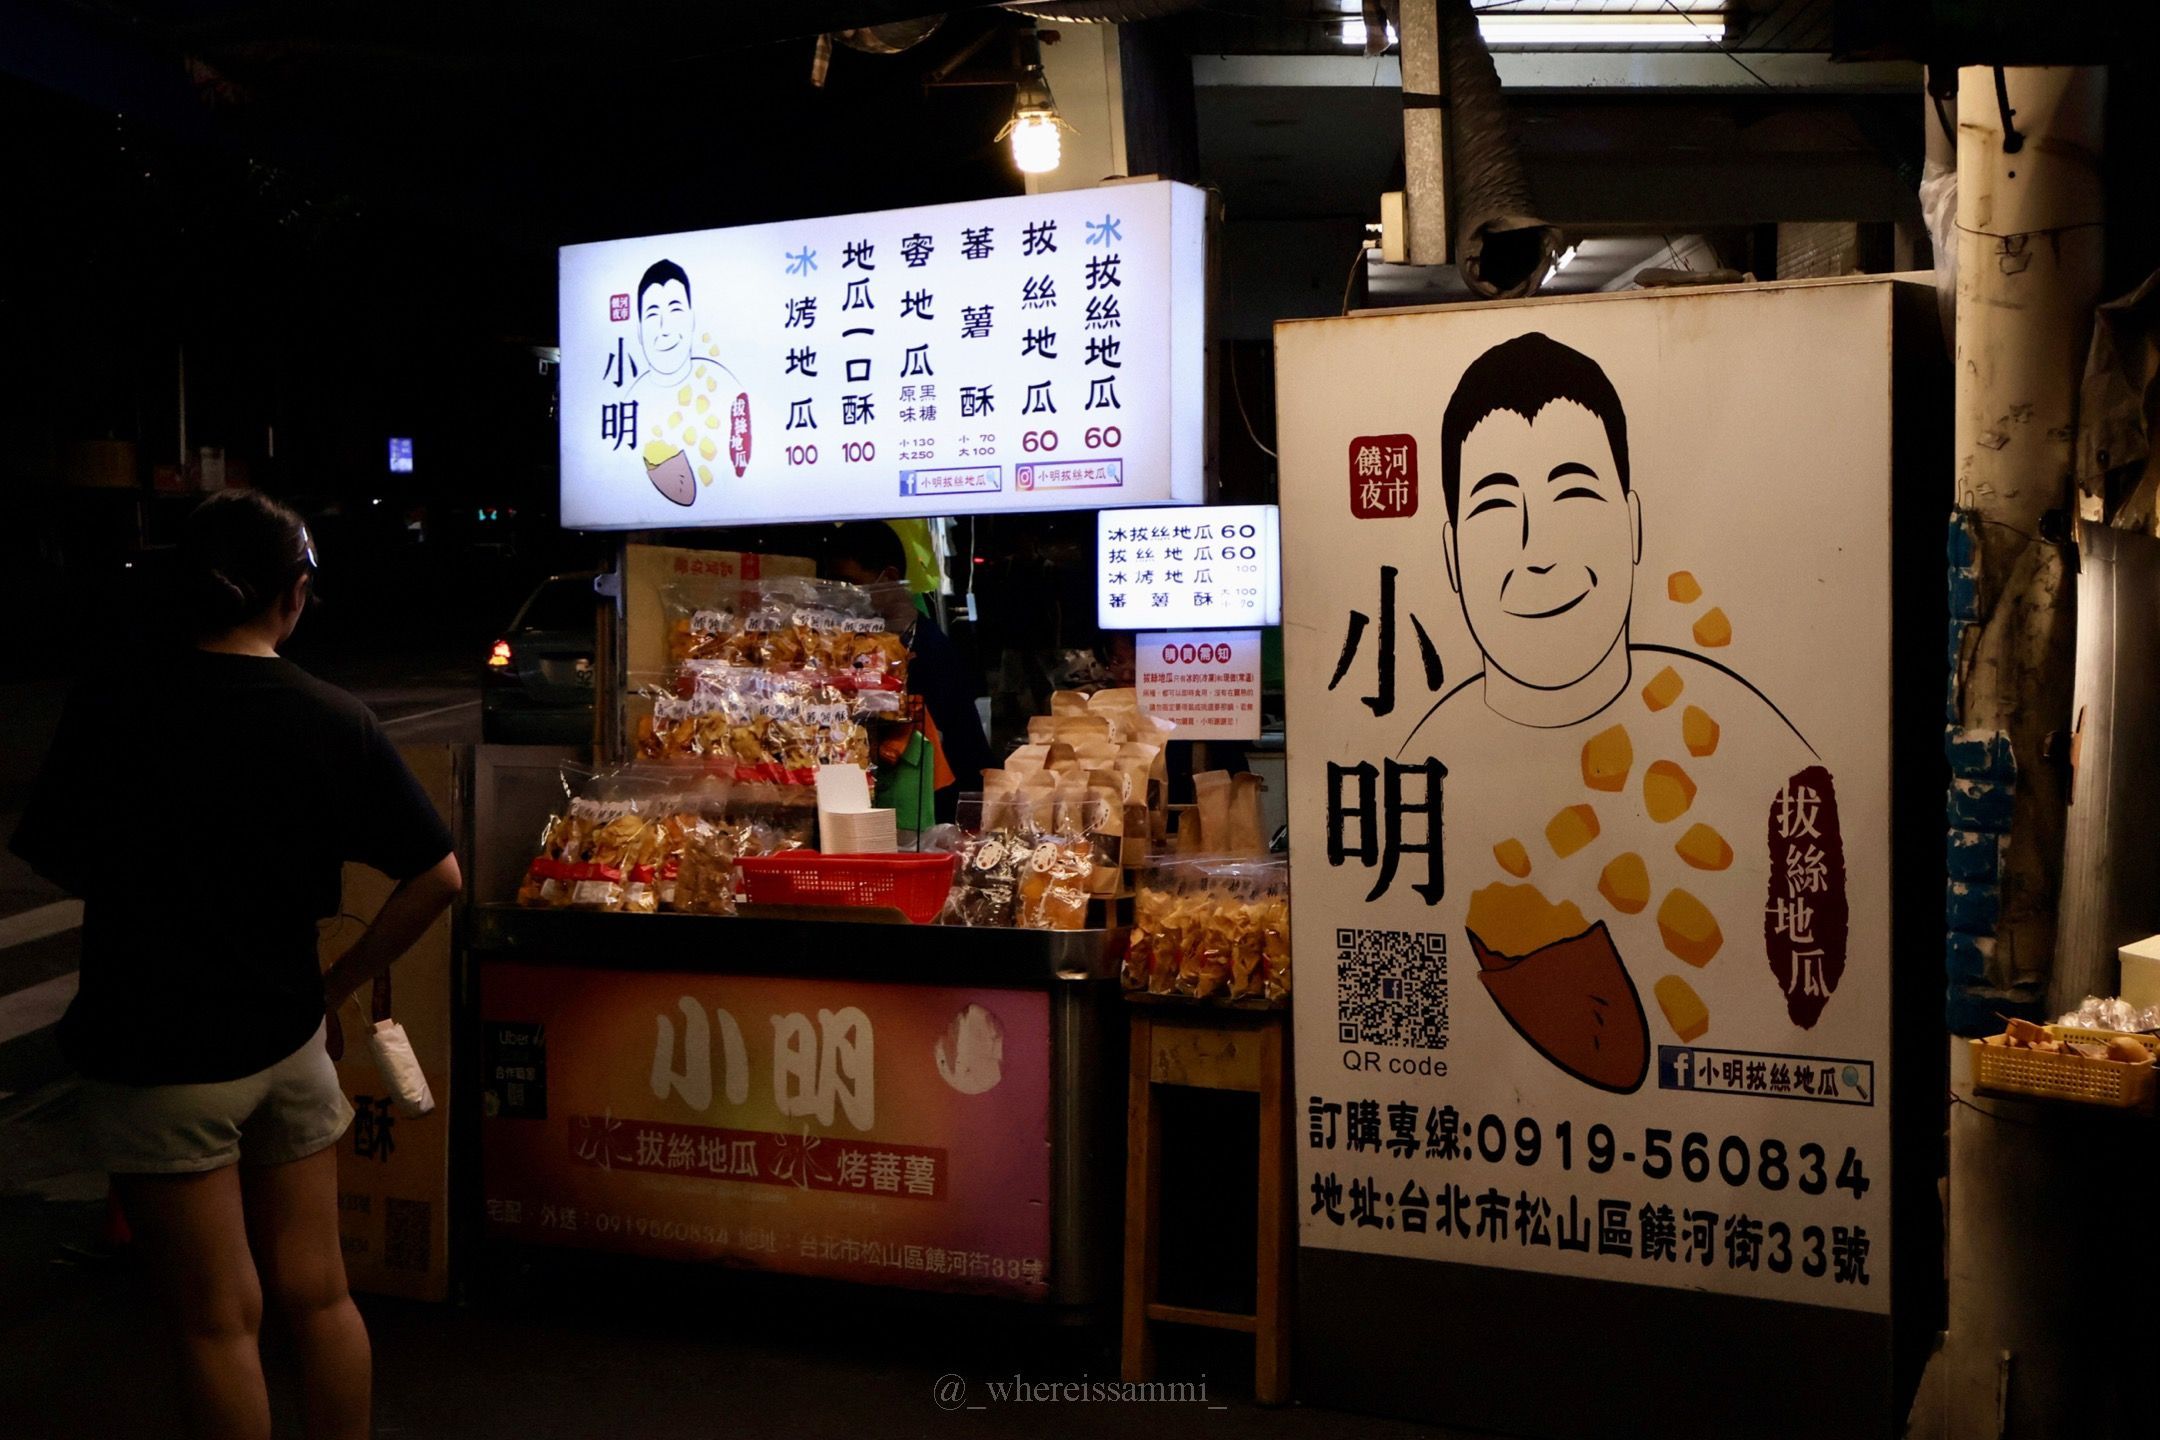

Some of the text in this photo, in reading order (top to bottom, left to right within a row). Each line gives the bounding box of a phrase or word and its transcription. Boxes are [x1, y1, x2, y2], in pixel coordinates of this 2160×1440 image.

[900, 233, 934, 378] 蜜地瓜
[960, 226, 995, 417] 蕃薯酥
[1022, 220, 1057, 415] 拔絲地瓜
[1085, 214, 1121, 411] 冰拔絲地瓜
[785, 245, 818, 430] 冰烤地瓜
[842, 238, 875, 425] 地瓜一口酥
[601, 337, 639, 451] 小明
[785, 444, 818, 465] 100
[842, 441, 875, 462] 100
[913, 437, 934, 446] 130
[973, 447, 995, 456] 100
[979, 434, 995, 442] 70
[1022, 430, 1058, 452] 60
[1085, 426, 1121, 449] 60
[1038, 467, 1106, 482] 小明拔絲地瓜
[1355, 444, 1409, 478] 饒河
[921, 473, 986, 489] 小明拔絲地瓜
[1359, 478, 1410, 512] 夜市
[1108, 524, 1256, 541] 冰拔絲地瓜 60
[1109, 546, 1256, 564] 拔絲地瓜 60
[1108, 565, 1257, 584] 冰烤地瓜 100
[1236, 588, 1257, 596] 100
[1328, 565, 1449, 905] 小明
[1767, 787, 1832, 999] 拔絲地瓜
[650, 996, 875, 1132] 小明
[1342, 1050, 1448, 1078] QR code
[1698, 1056, 1839, 1098] 小明拔絲地瓜
[355, 1095, 394, 1162] 酥
[1308, 1096, 1870, 1200] 訂購專線:0919-560834
[1310, 1172, 1871, 1286] 地址:台北市松山區饒河街33號
